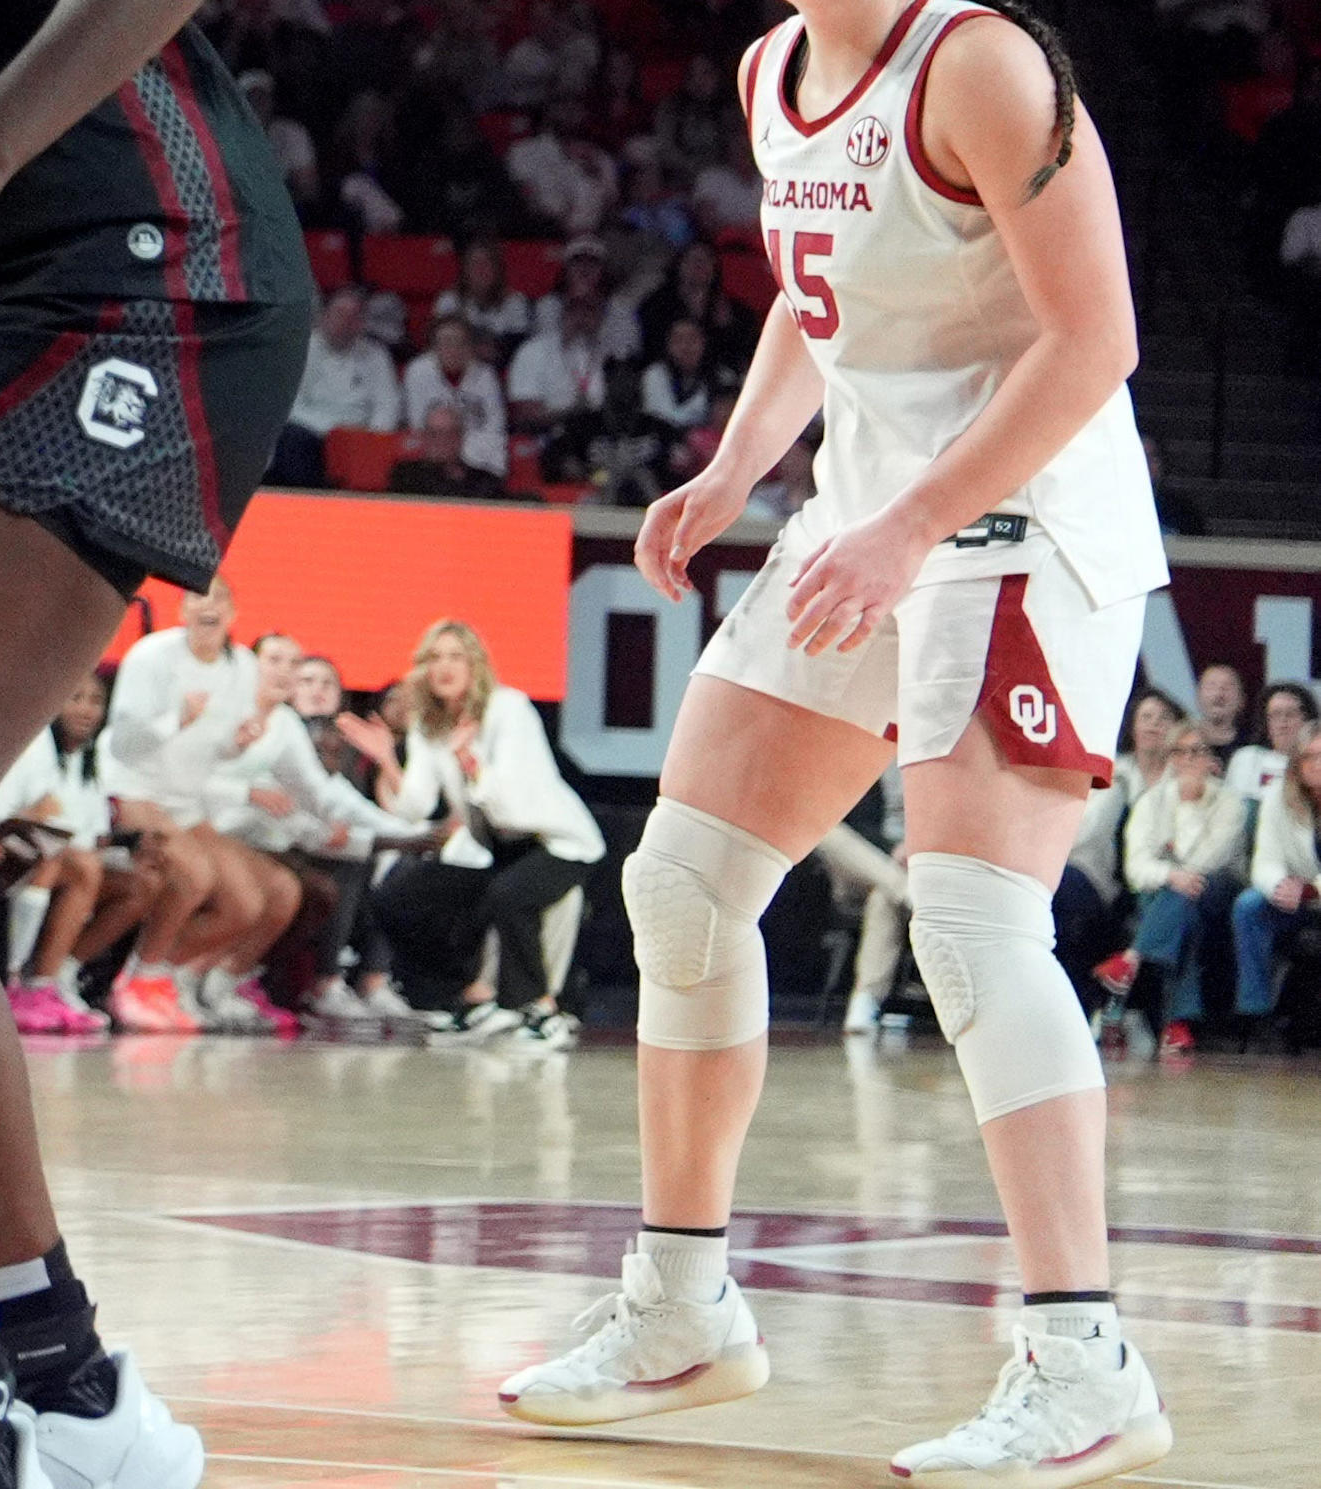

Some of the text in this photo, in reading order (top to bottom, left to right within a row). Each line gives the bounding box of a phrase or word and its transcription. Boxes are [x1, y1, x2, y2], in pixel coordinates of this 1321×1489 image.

[847, 117, 889, 166] SEC
[768, 229, 839, 340] 15
[1009, 684, 1057, 745] OU
